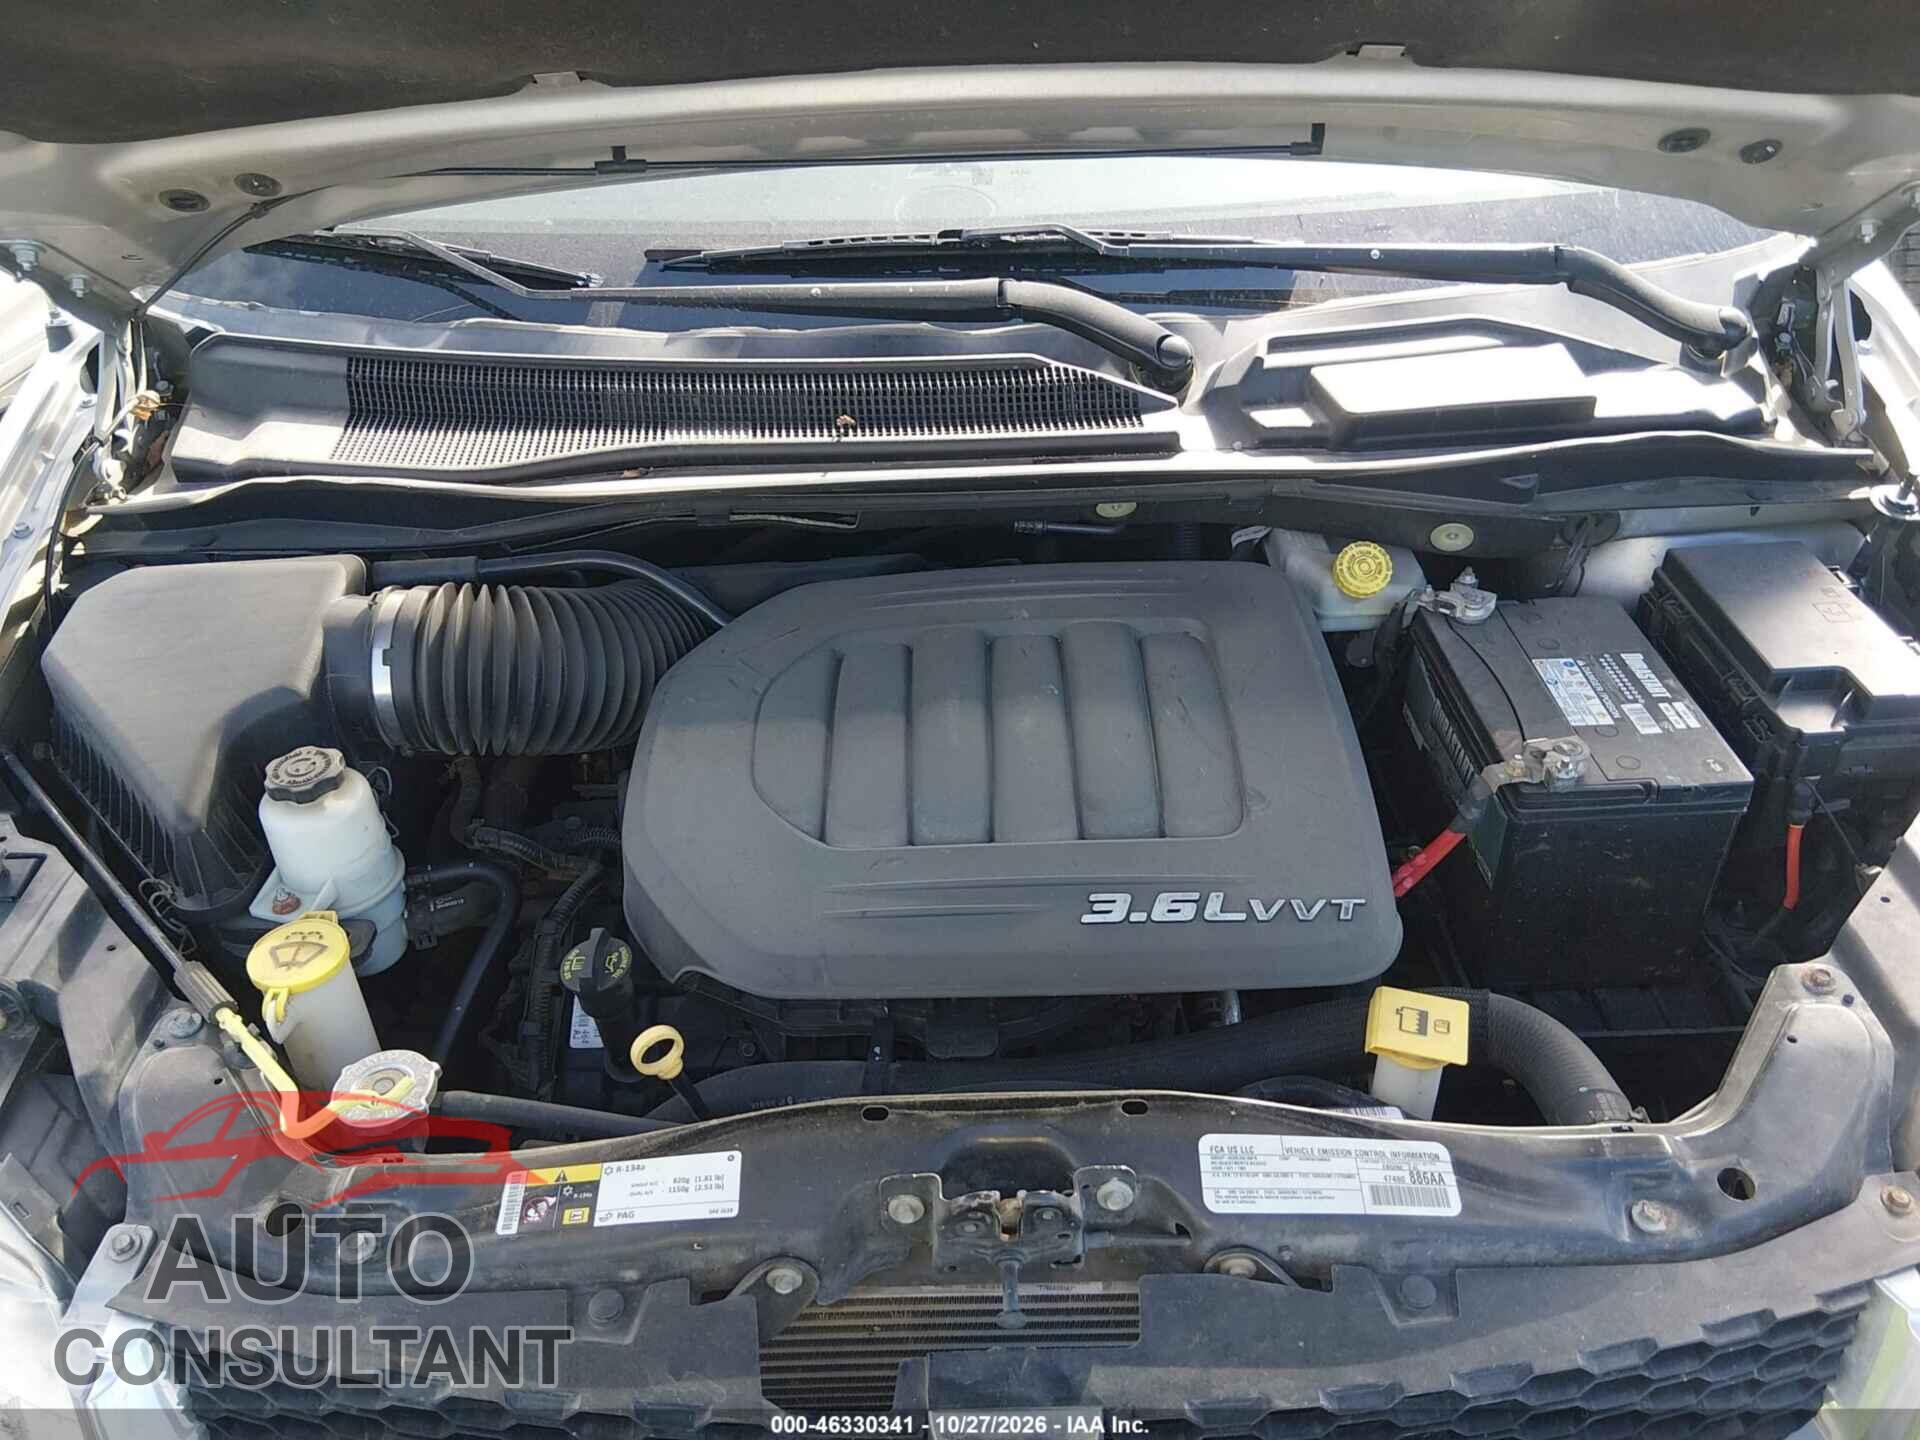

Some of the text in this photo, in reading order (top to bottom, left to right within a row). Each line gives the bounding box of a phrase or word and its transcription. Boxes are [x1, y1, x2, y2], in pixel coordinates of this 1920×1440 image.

[1080, 891, 1368, 925] 3.6L VVT
[1209, 1145, 1254, 1154] FCA US LLC
[1285, 1147, 1440, 1160] VEHICLE EMISSION CONTROL INFORMATION
[617, 1211, 635, 1219] PAG
